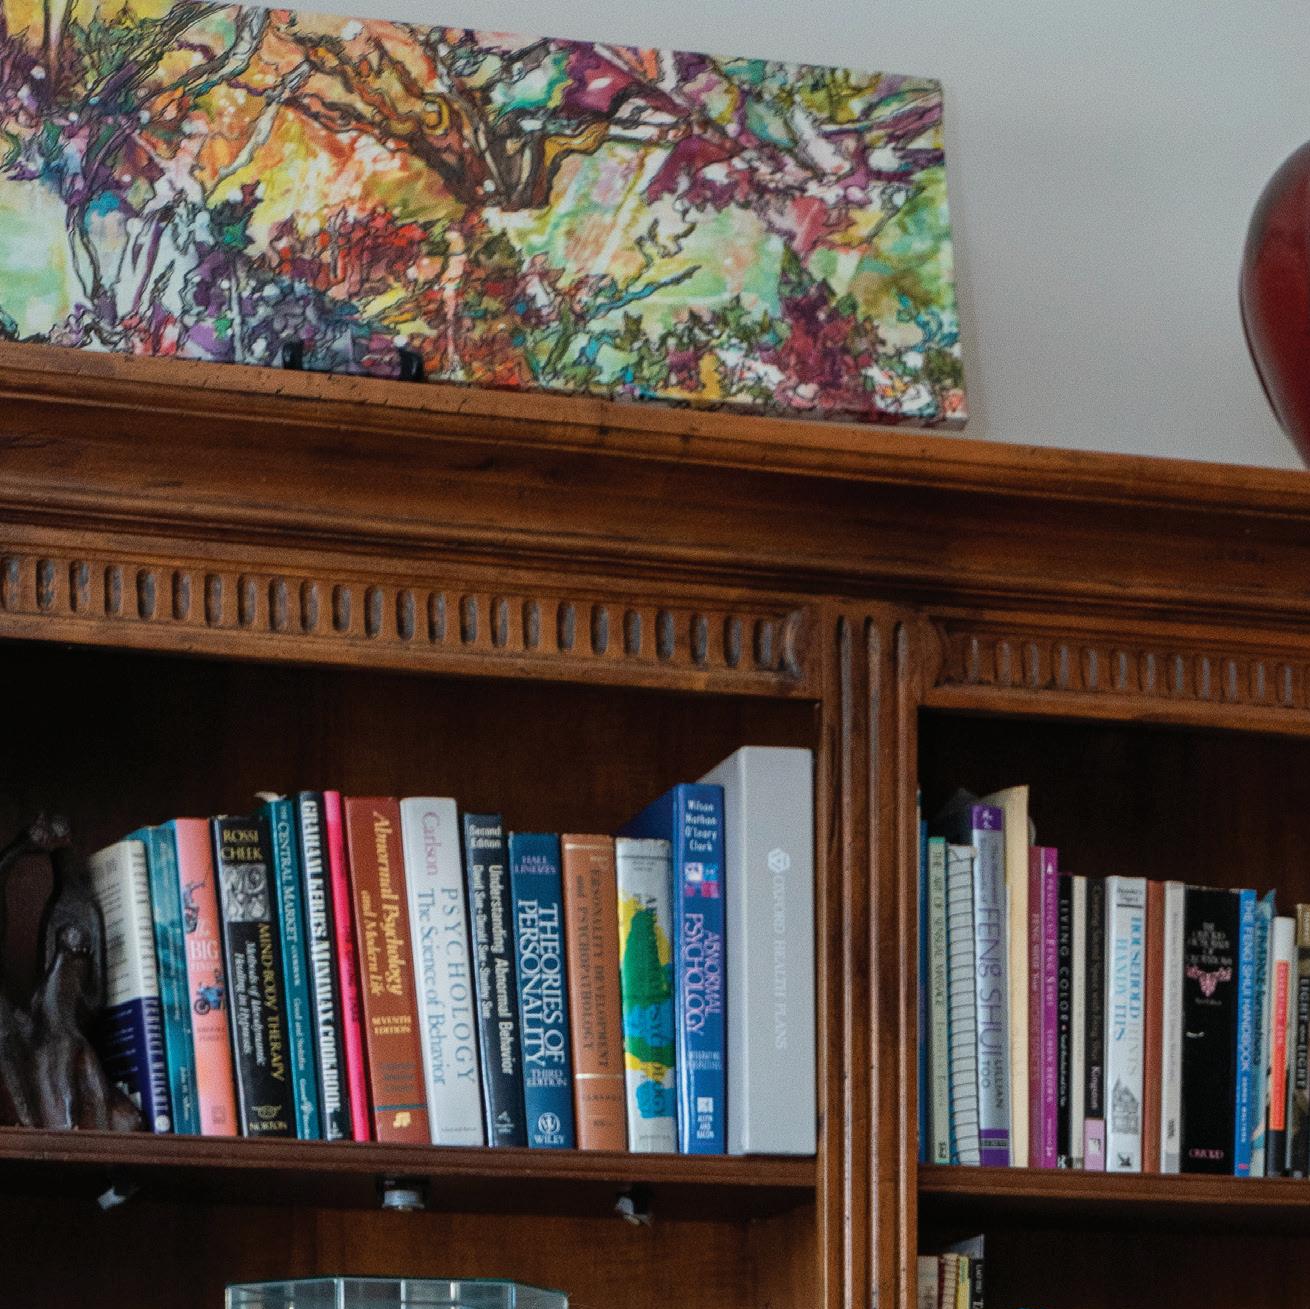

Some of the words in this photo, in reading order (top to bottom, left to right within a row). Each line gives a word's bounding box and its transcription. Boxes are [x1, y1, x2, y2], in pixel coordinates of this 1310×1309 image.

[277, 821, 293, 882] CENTRAL
[373, 811, 398, 899] Abnormal
[420, 812, 440, 876] Carlson
[283, 885, 299, 942] MARKET
[417, 888, 437, 919] The
[489, 865, 509, 954] Understanding
[1060, 899, 1070, 957] LIVING
[1243, 900, 1254, 925] THE
[302, 801, 325, 878] GRAHAM
[320, 1026, 341, 1113] COOKBOOK
[381, 904, 407, 996] Psychology
[421, 925, 441, 985] Science
[538, 902, 561, 1024] THEORIES
[683, 913, 705, 1036] PSYCHOLOGY
[703, 931, 722, 1017] ABNORMAL
[979, 908, 1002, 979] FENG
[1115, 939, 1128, 996] HANDY
[1129, 916, 1143, 1020] HOUSEHOLD
[1243, 926, 1254, 961] FENG
[426, 988, 446, 1007] of
[441, 887, 475, 1083] PSYCHOLOGY
[496, 958, 512, 1018] Abnormal
[518, 899, 546, 1065] PERSONALITY
[1060, 966, 1070, 1021] COLOR
[1242, 964, 1254, 998] SHUI
[267, 1015, 284, 1081] THERAPY
[427, 1013, 448, 1086] Behavior
[499, 1021, 516, 1075] Behavior
[543, 1029, 566, 1065] OF
[980, 989, 1003, 1057] SHUI
[1240, 999, 1253, 1072] HANDBOOK
[533, 1135, 566, 1146] WILEY
